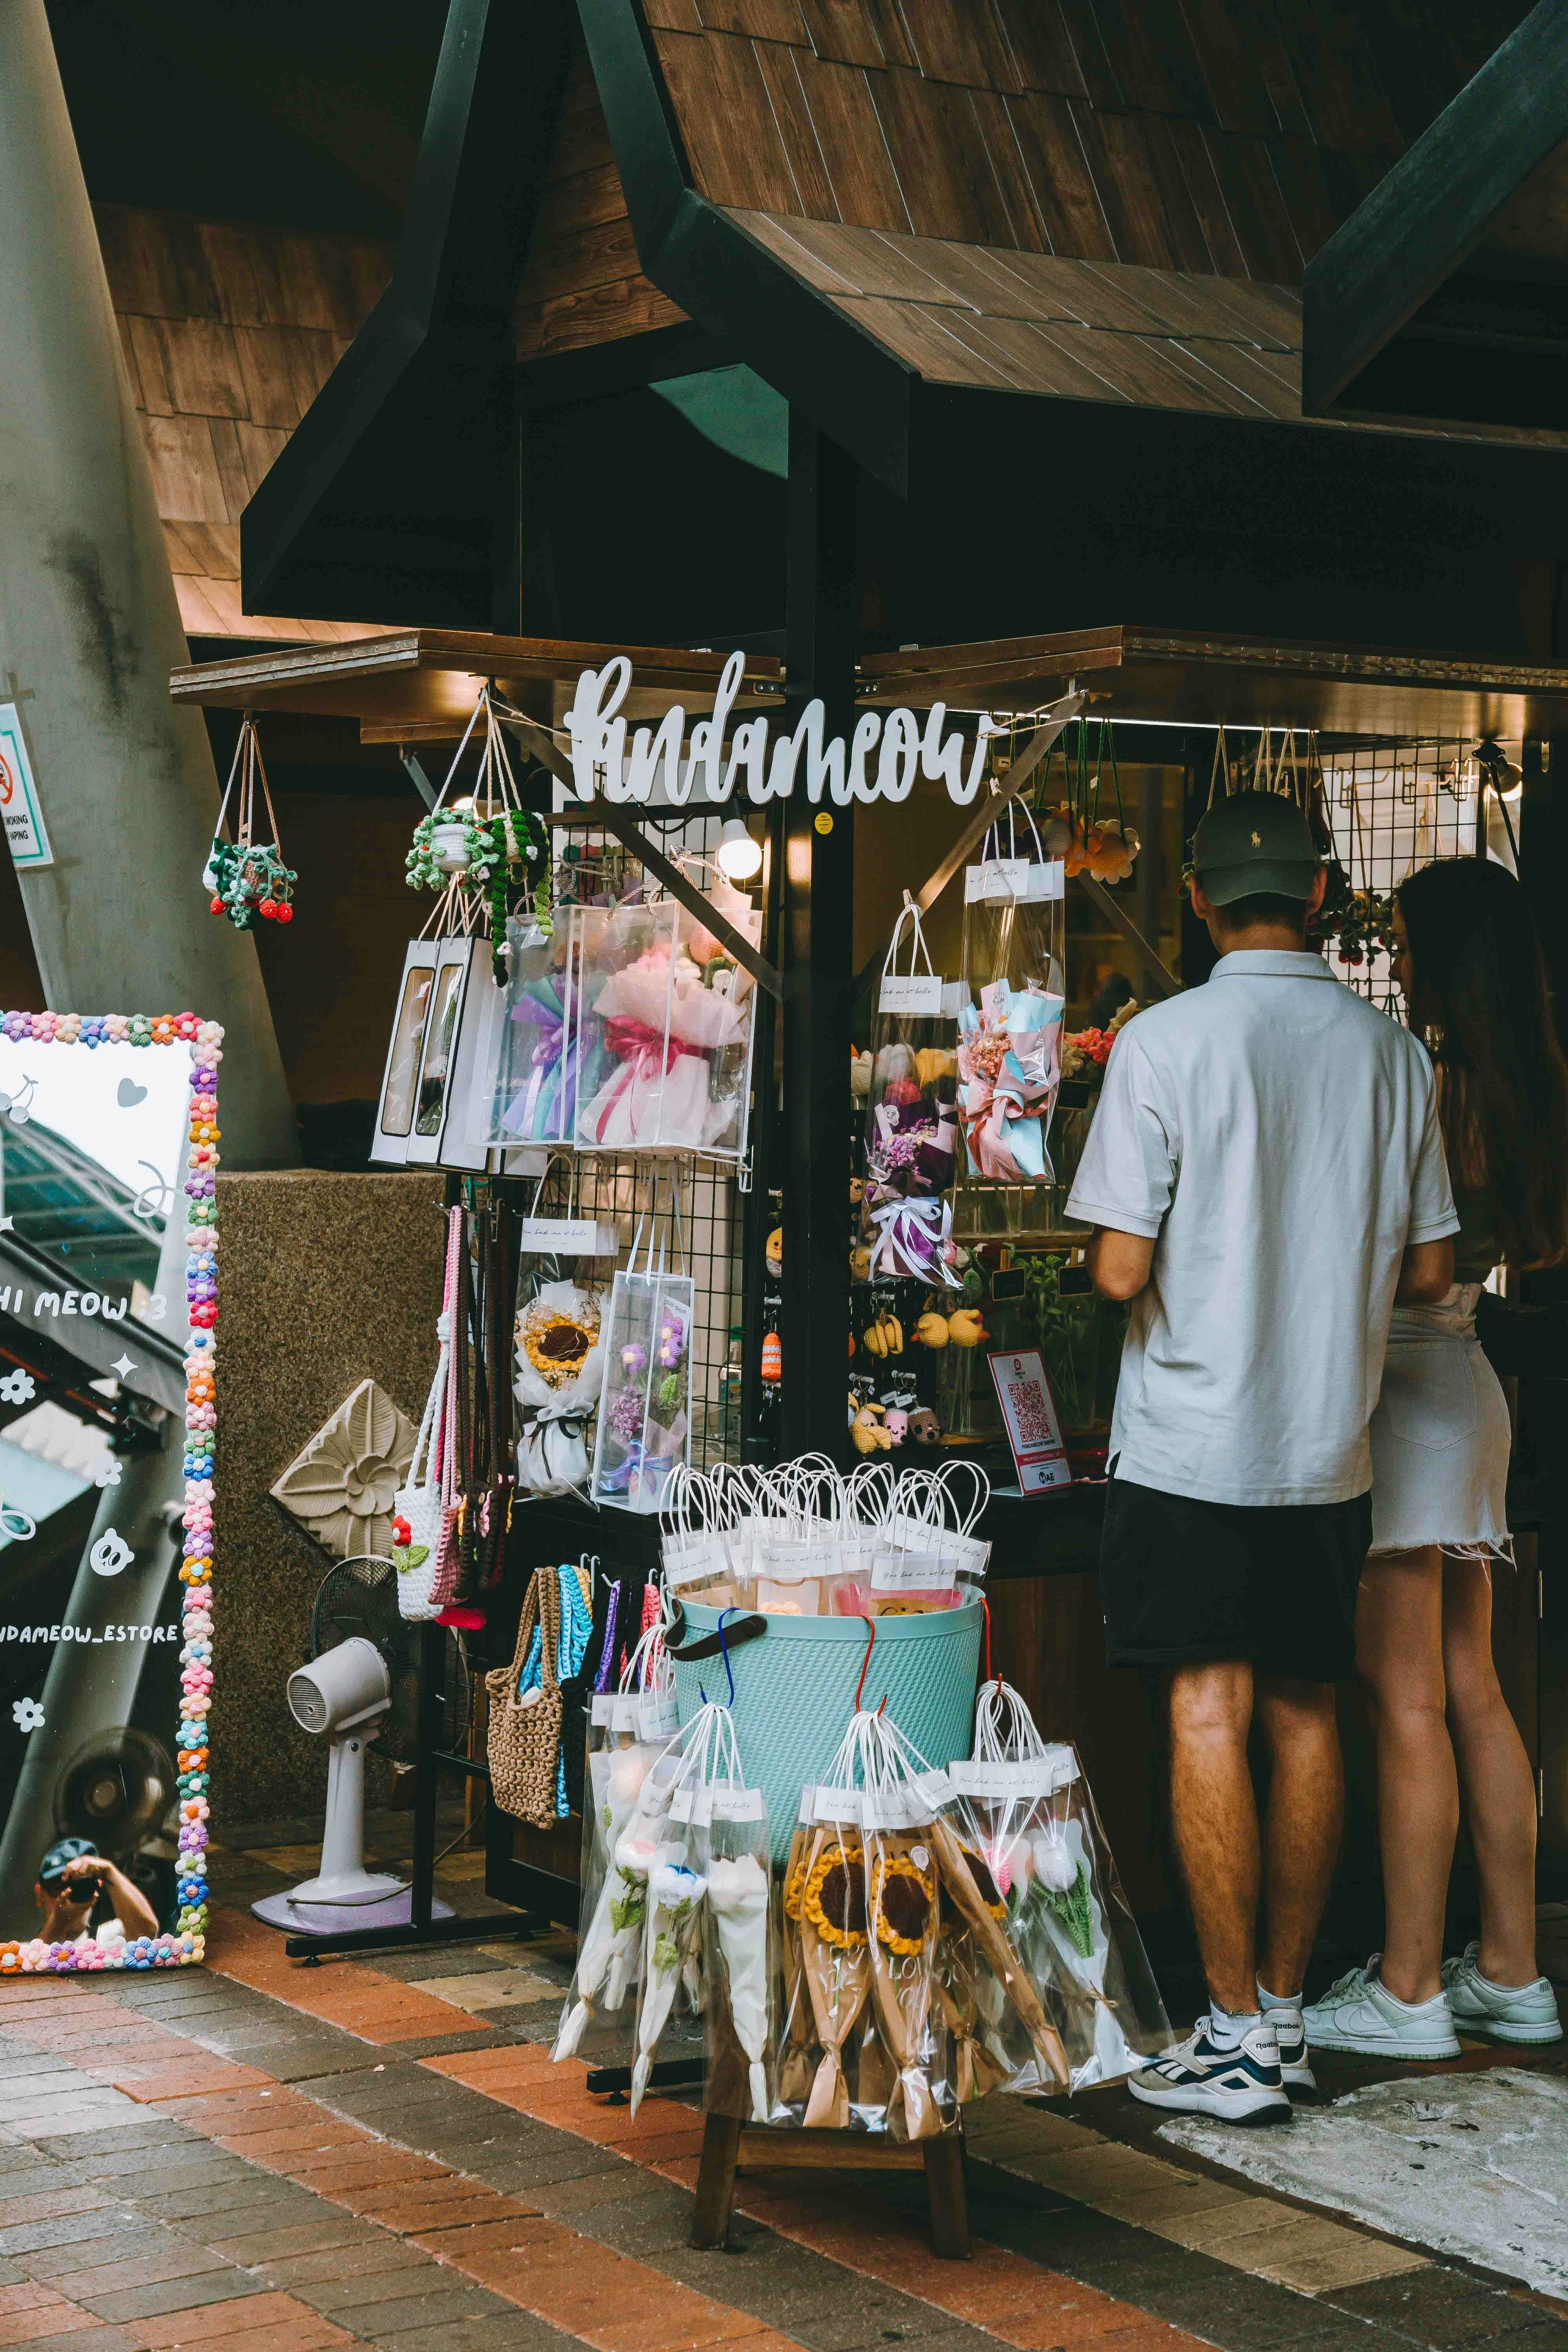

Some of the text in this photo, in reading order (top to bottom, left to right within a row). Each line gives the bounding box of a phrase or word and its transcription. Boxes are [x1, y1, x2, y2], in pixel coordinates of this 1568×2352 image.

[9, 830, 28, 841] VAPING
[34, 1290, 127, 1320] MEOW
[1256, 2041, 1278, 2050] Reebo
